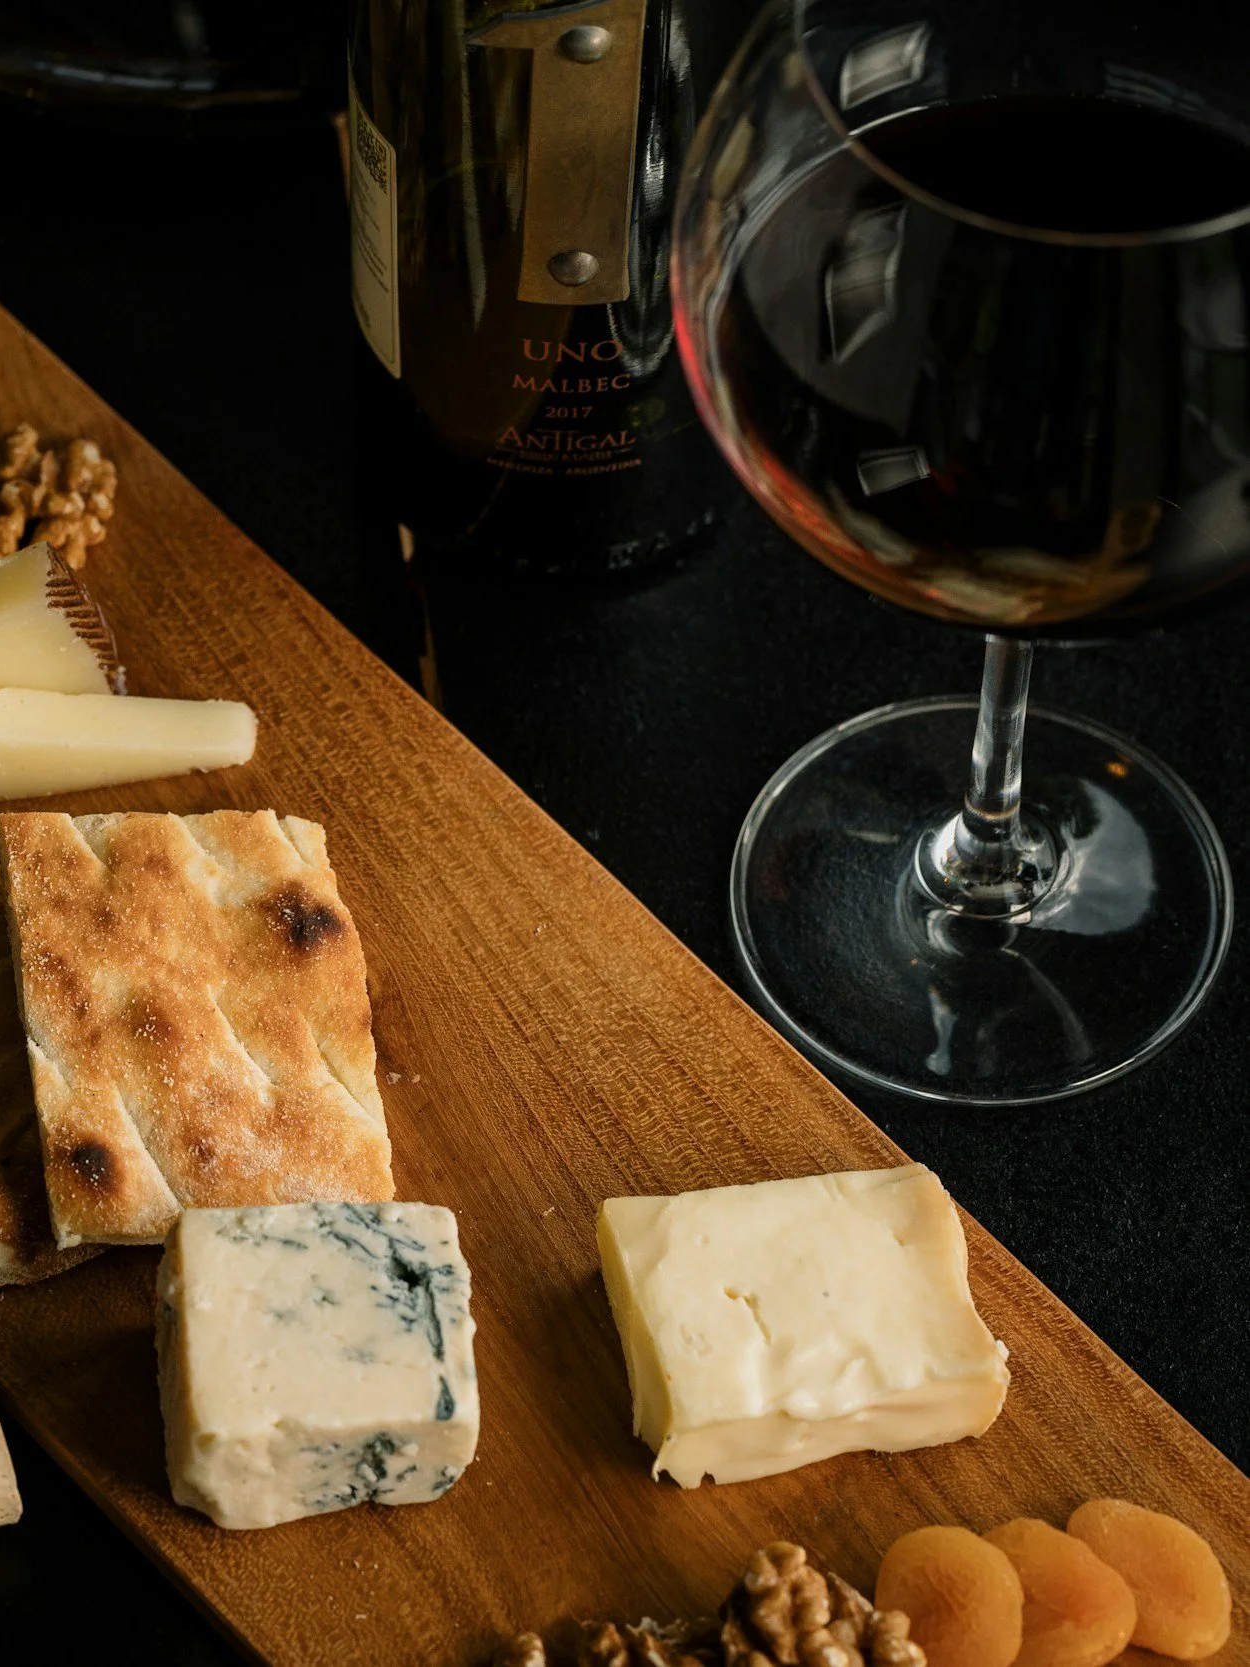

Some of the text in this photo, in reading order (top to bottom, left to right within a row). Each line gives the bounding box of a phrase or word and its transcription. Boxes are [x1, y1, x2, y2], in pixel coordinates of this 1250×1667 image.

[522, 338, 624, 364] UNO
[511, 373, 632, 394] MALBEC
[544, 405, 594, 420] 2017
